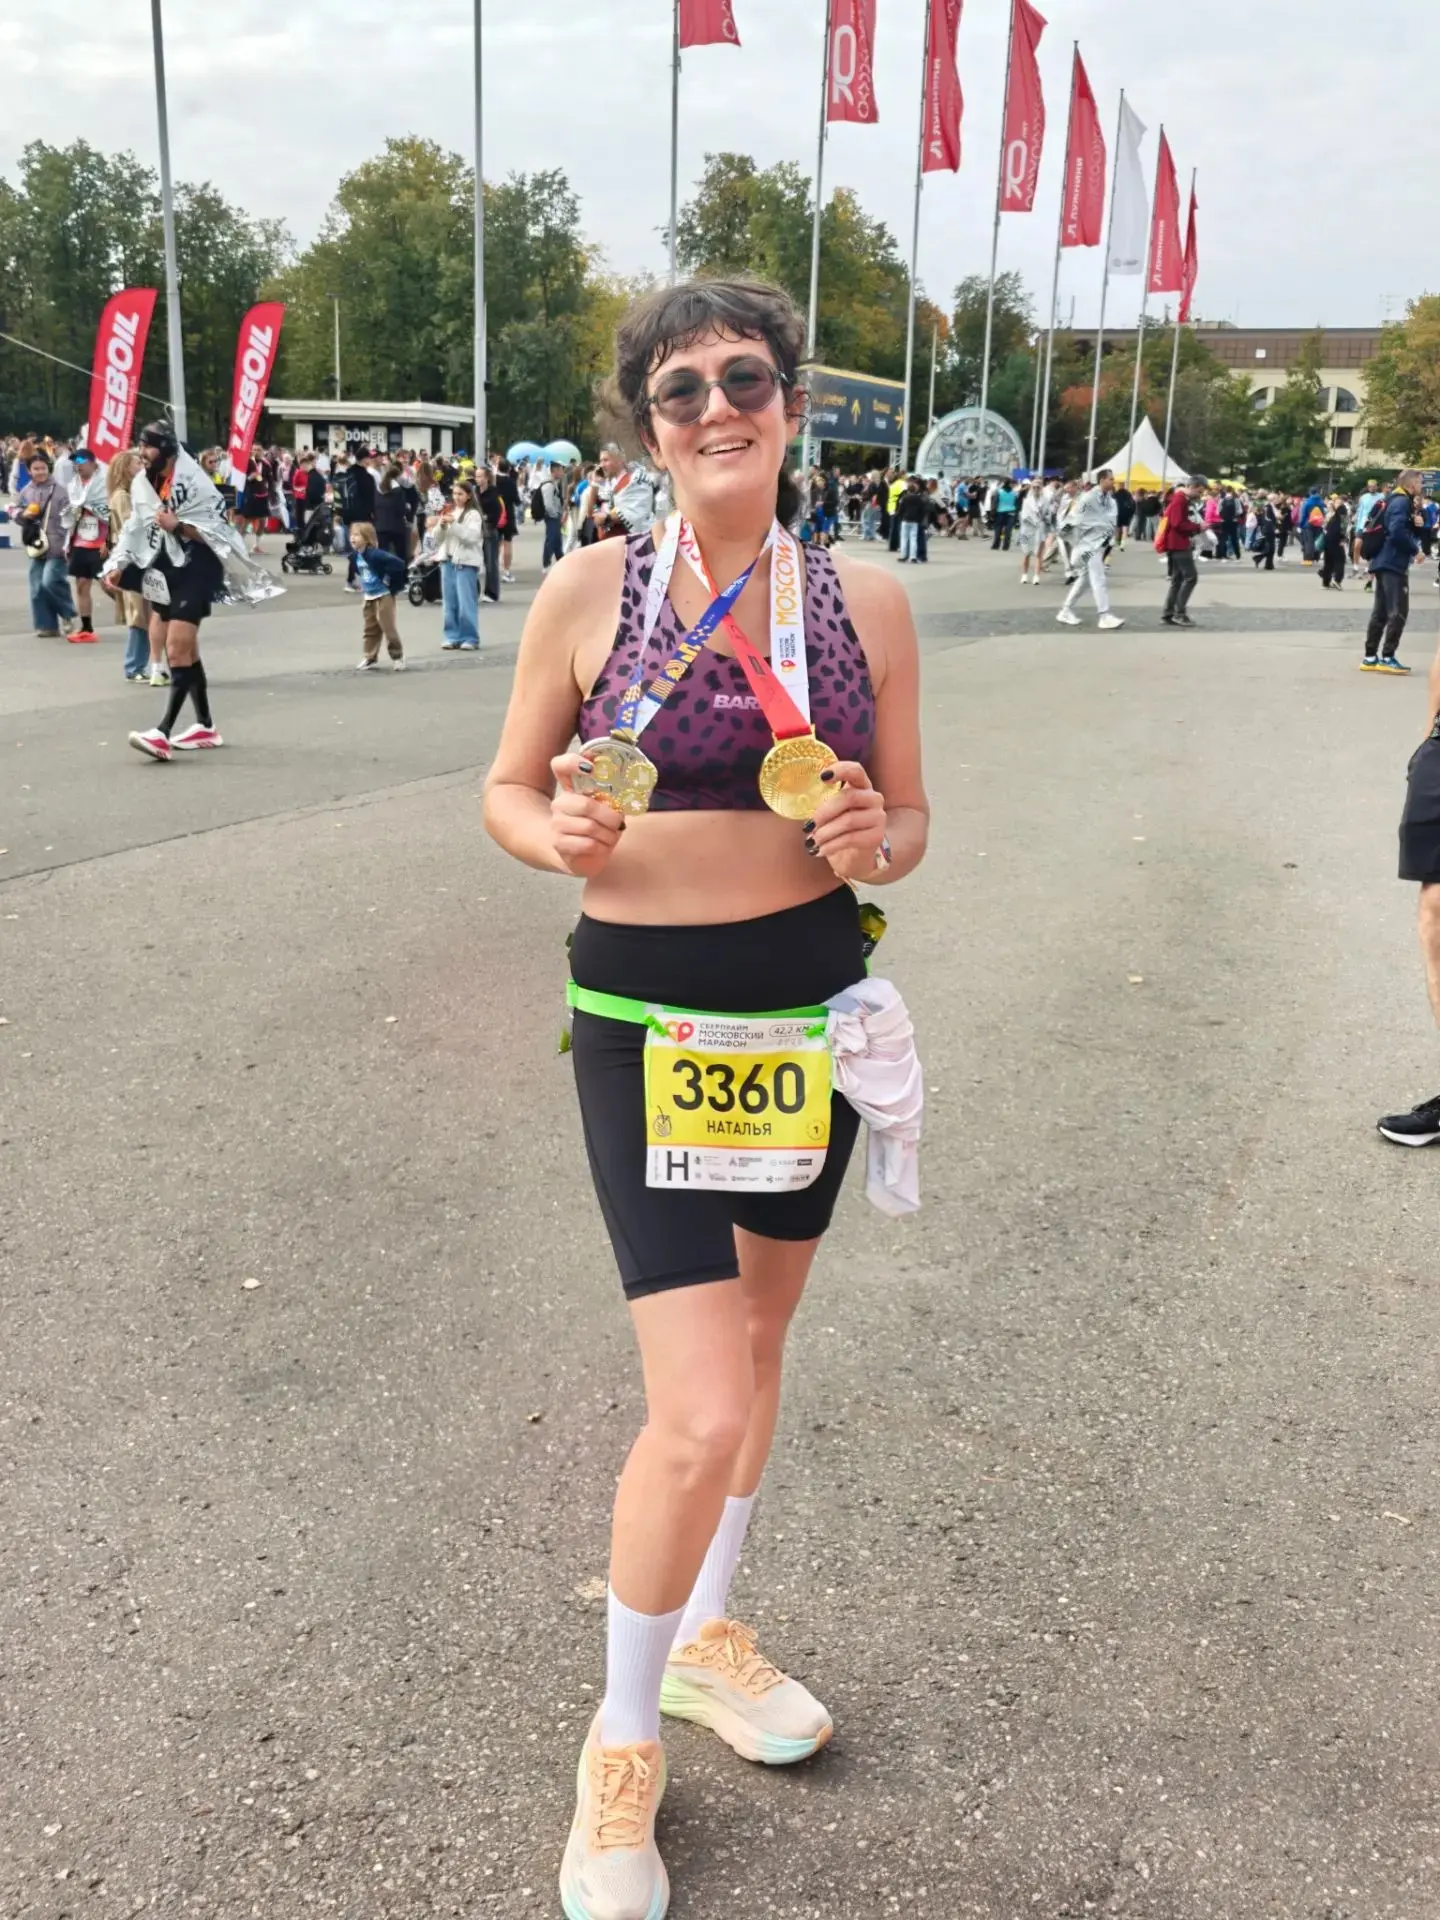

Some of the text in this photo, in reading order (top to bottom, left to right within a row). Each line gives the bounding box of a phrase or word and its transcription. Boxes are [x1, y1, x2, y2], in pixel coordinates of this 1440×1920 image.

[1071, 157, 1083, 220] ЛУЖНИКИ
[96, 311, 139, 448] TEBOIL
[345, 428, 385, 442] DÖNER
[776, 539, 799, 626] MOSCOW
[713, 694, 760, 709] BAR
[700, 1023, 748, 1031] СБЕРПРАЙМ
[699, 1030, 764, 1040] МОСКОВСКИЙ
[698, 1038, 747, 1048] МАРАФОН
[672, 1059, 805, 1115] 3360
[707, 1120, 772, 1136] НАТАЛЬЯ
